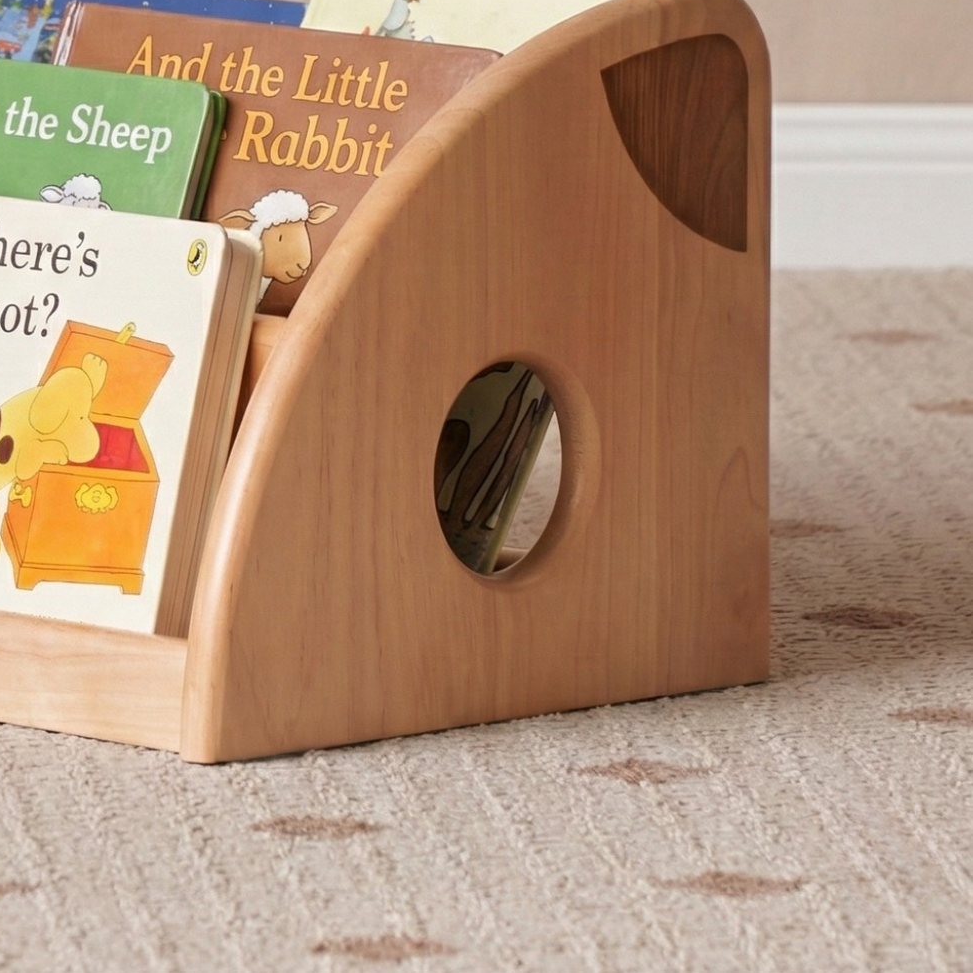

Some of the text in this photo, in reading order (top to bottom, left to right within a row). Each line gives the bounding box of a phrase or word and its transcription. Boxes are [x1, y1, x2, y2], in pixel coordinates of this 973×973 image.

[126, 35, 408, 112] And the Little
[4, 96, 60, 136] the
[66, 103, 172, 164] Sheep
[232, 109, 394, 178] Rabbit
